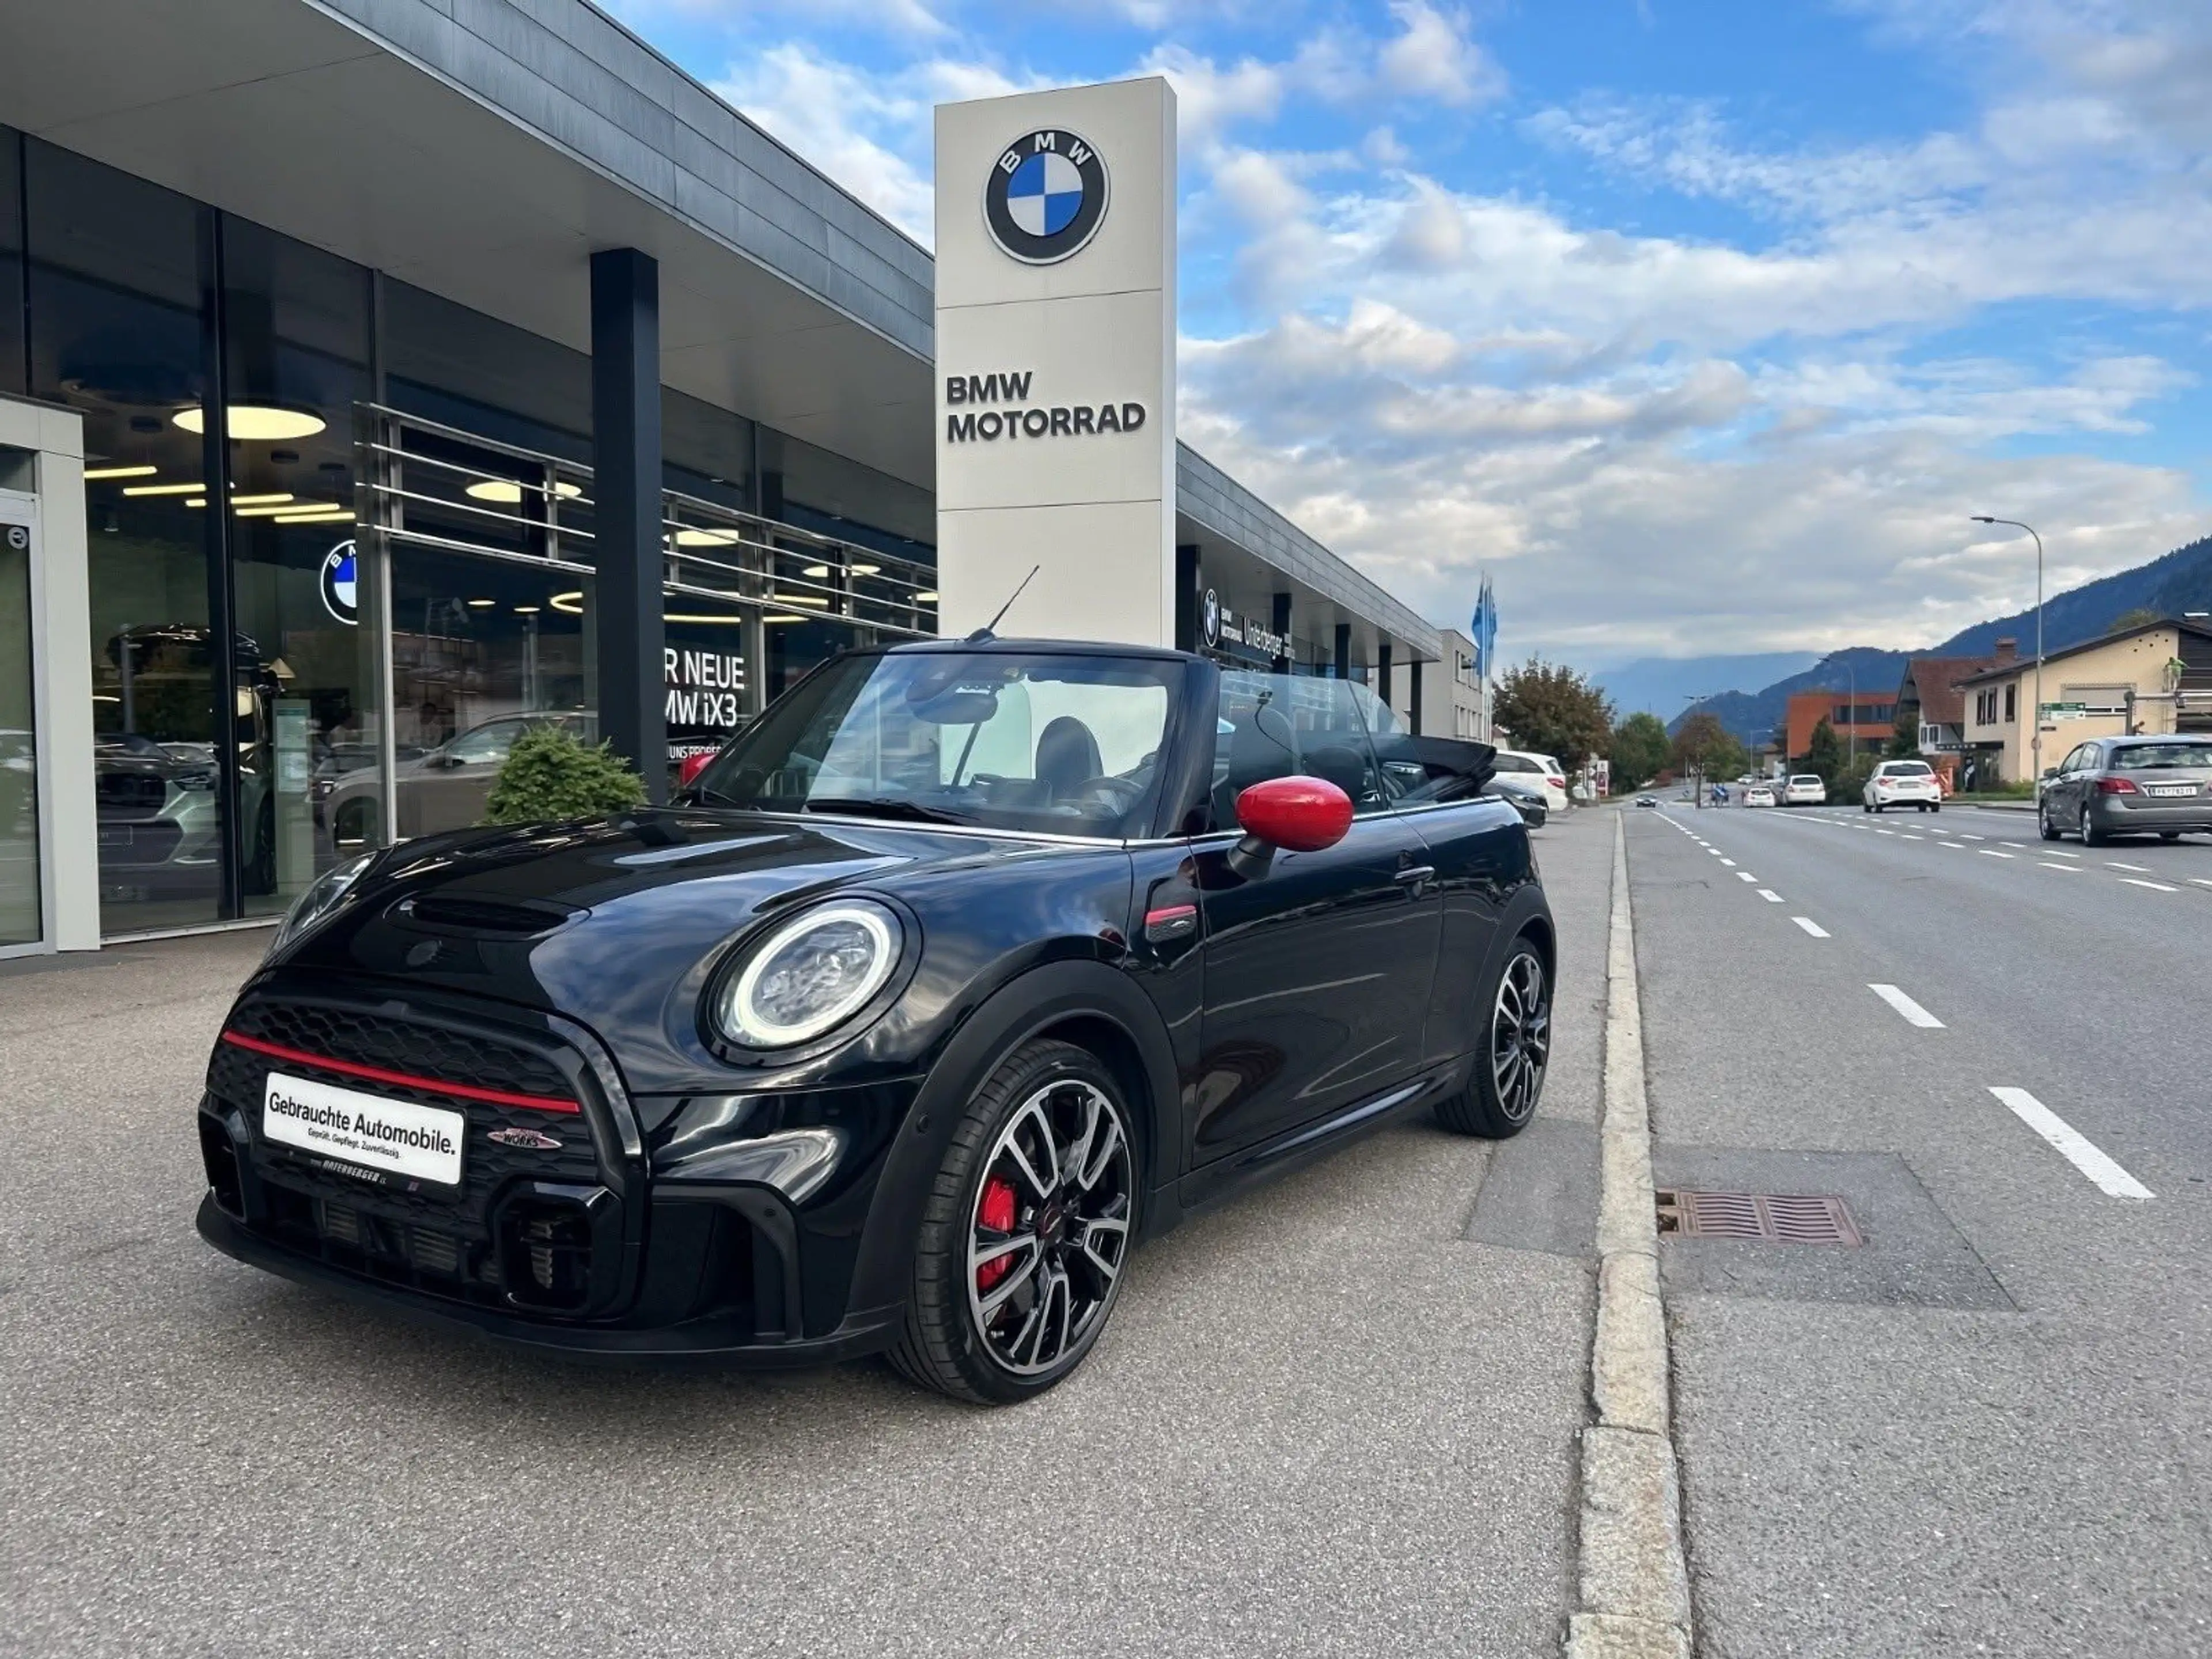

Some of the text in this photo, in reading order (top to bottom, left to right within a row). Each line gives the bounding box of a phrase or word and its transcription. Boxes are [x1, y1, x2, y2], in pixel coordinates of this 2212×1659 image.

[999, 132, 1092, 174] BMW
[946, 370, 1033, 404] BMW
[947, 402, 1146, 443] MOTORRAD
[684, 649, 745, 690] NEUE
[703, 692, 737, 727] iX3
[269, 1092, 456, 1155] Gebrauchte Automobile.
